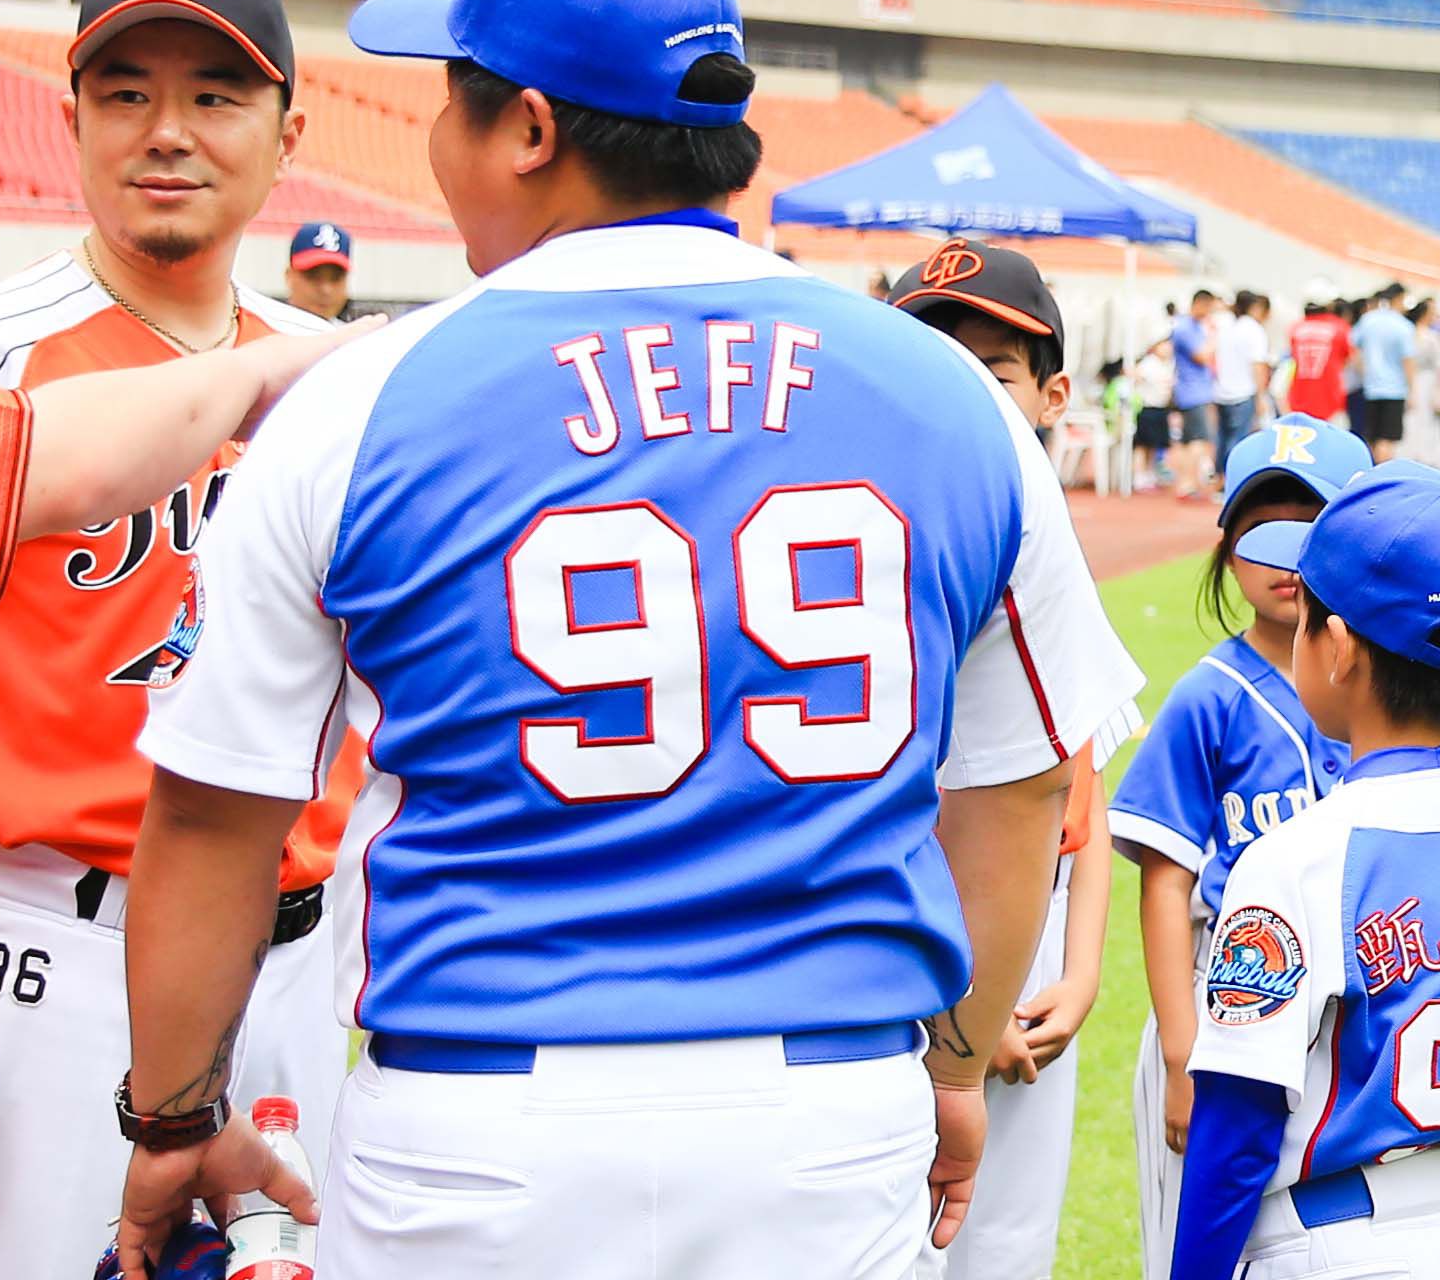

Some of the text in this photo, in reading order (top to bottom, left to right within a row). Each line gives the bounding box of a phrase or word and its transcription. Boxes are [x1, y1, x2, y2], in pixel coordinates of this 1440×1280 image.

[549, 320, 822, 456] JEFF
[1270, 423, 1317, 465] R
[504, 478, 918, 804] 99
